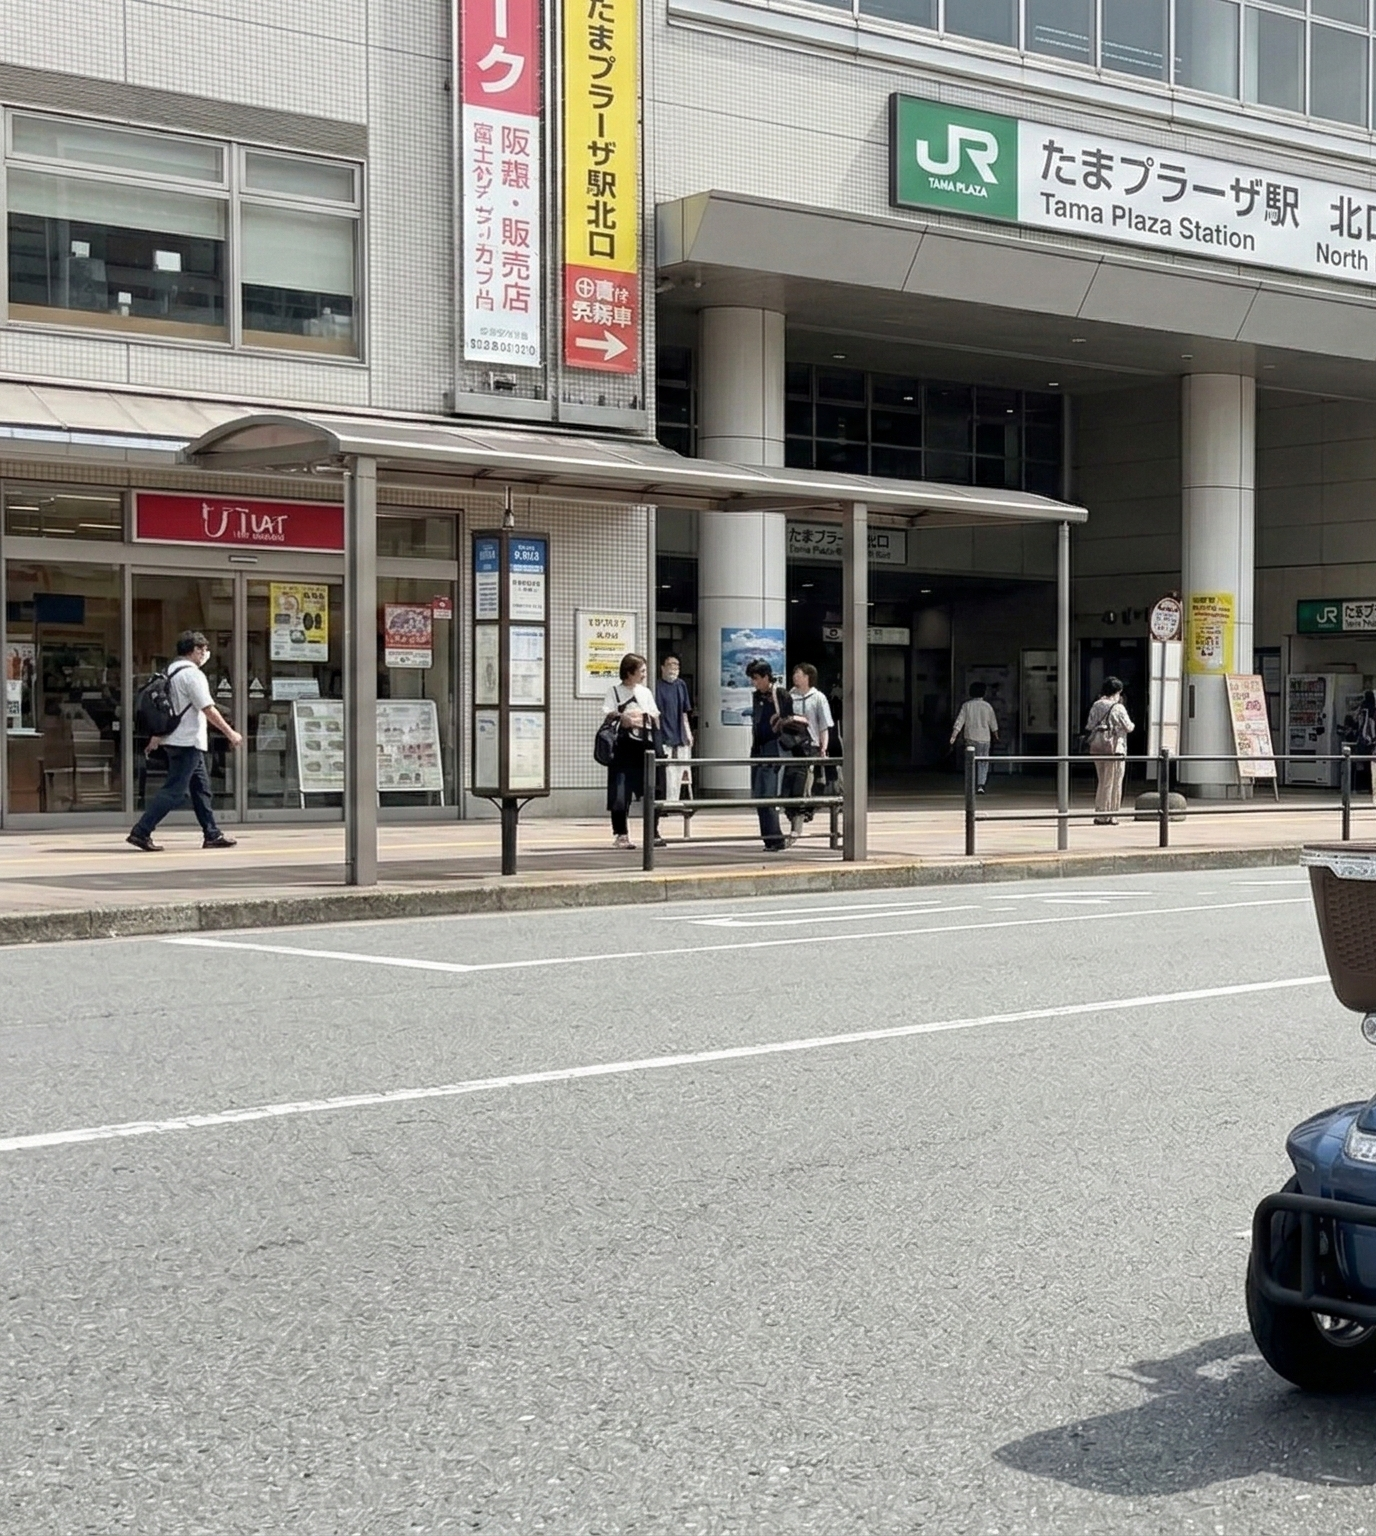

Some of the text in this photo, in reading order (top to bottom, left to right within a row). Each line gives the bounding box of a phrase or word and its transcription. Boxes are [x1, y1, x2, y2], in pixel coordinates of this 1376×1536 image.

[586, 0, 617, 260] たまプラーザ駅北口
[916, 124, 999, 184] JR
[956, 183, 988, 198] PLAZA
[1041, 139, 1300, 229] たまプラーザ駅
[1040, 192, 1255, 251] Tama Plaza Station
[1316, 241, 1368, 271] North
[1316, 606, 1338, 624] JR
